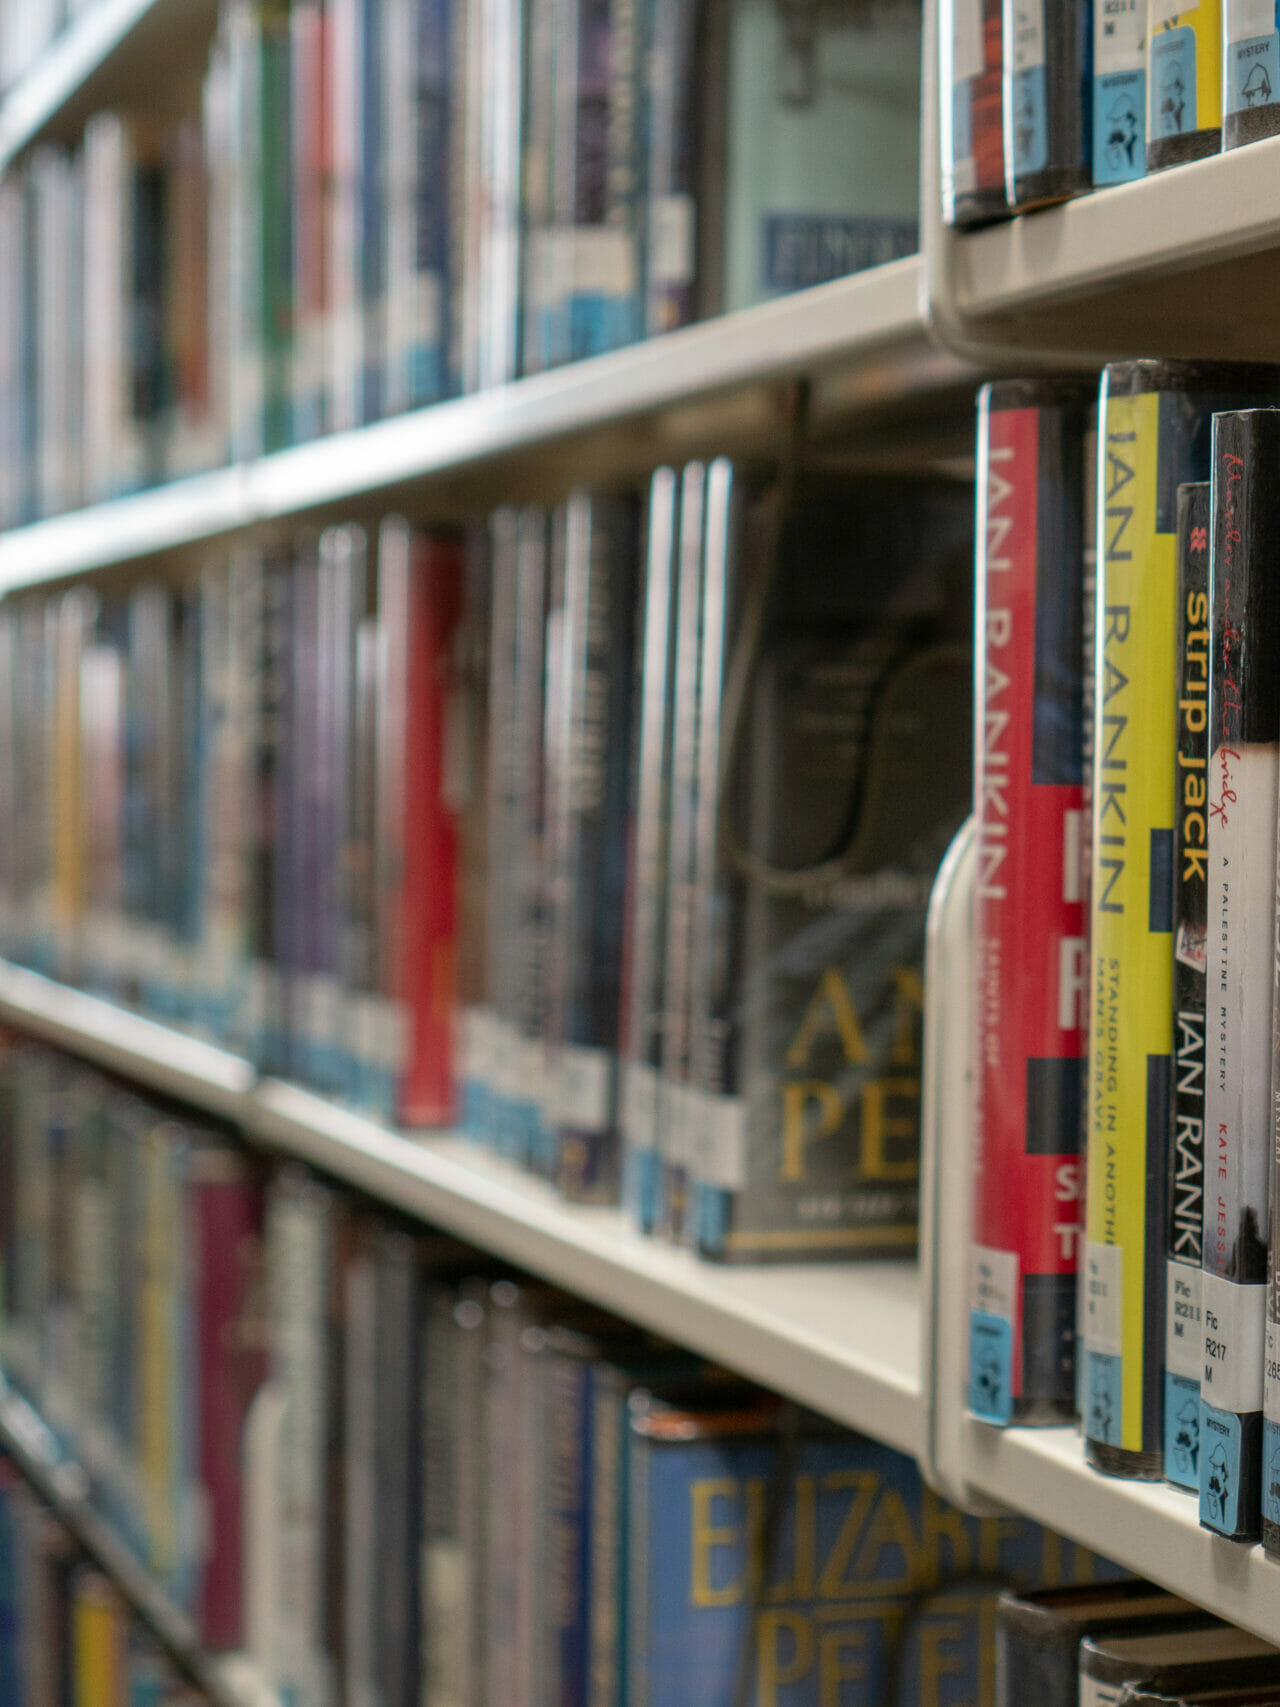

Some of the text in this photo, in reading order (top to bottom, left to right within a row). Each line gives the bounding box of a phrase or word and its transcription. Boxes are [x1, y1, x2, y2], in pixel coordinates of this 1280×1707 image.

[1221, 453, 1244, 571] Murder
[980, 447, 1013, 899] IAN RANKIN
[1098, 431, 1137, 914] IAN RANKIN
[1180, 591, 1209, 884] strip jack
[1222, 679, 1241, 743] the
[1208, 748, 1241, 829] bridge
[1219, 857, 1229, 1093] A PALESTINE MYSTERY
[1105, 957, 1120, 1093] STANDING
[1177, 1010, 1203, 1096] IAN
[1106, 1104, 1117, 1132] IN
[1217, 1122, 1228, 1181] KATE
[1174, 1280, 1191, 1298] Fic
[1205, 1310, 1218, 1330] Fic
[1205, 1337, 1227, 1361] R217
[1205, 1365, 1213, 1383] M
[1206, 1417, 1231, 1437] MYSTERY
